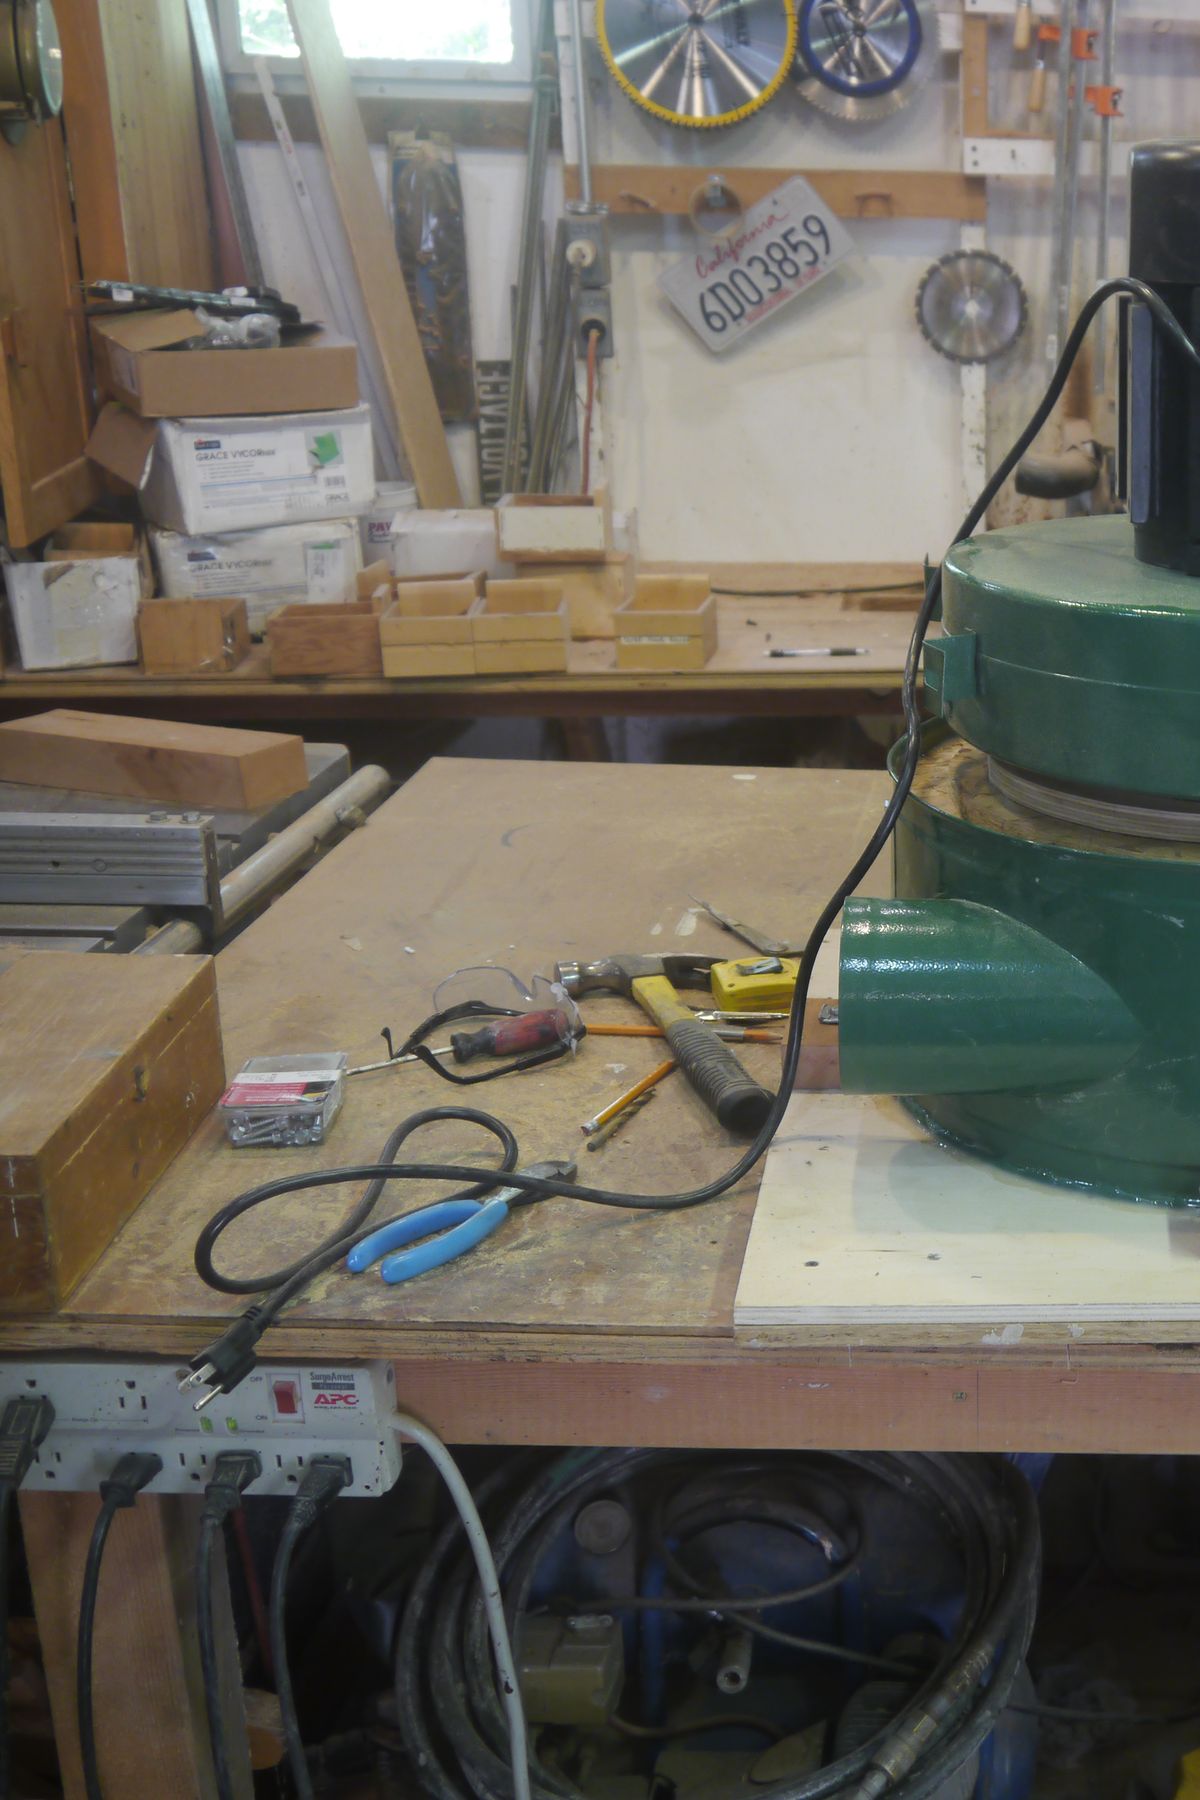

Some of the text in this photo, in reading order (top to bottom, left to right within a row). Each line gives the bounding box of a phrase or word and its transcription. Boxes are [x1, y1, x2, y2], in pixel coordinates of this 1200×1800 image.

[695, 212, 790, 279] California
[699, 214, 831, 333] 6D03859
[195, 451, 229, 463] GRACE
[314, 1393, 359, 1405] APC
